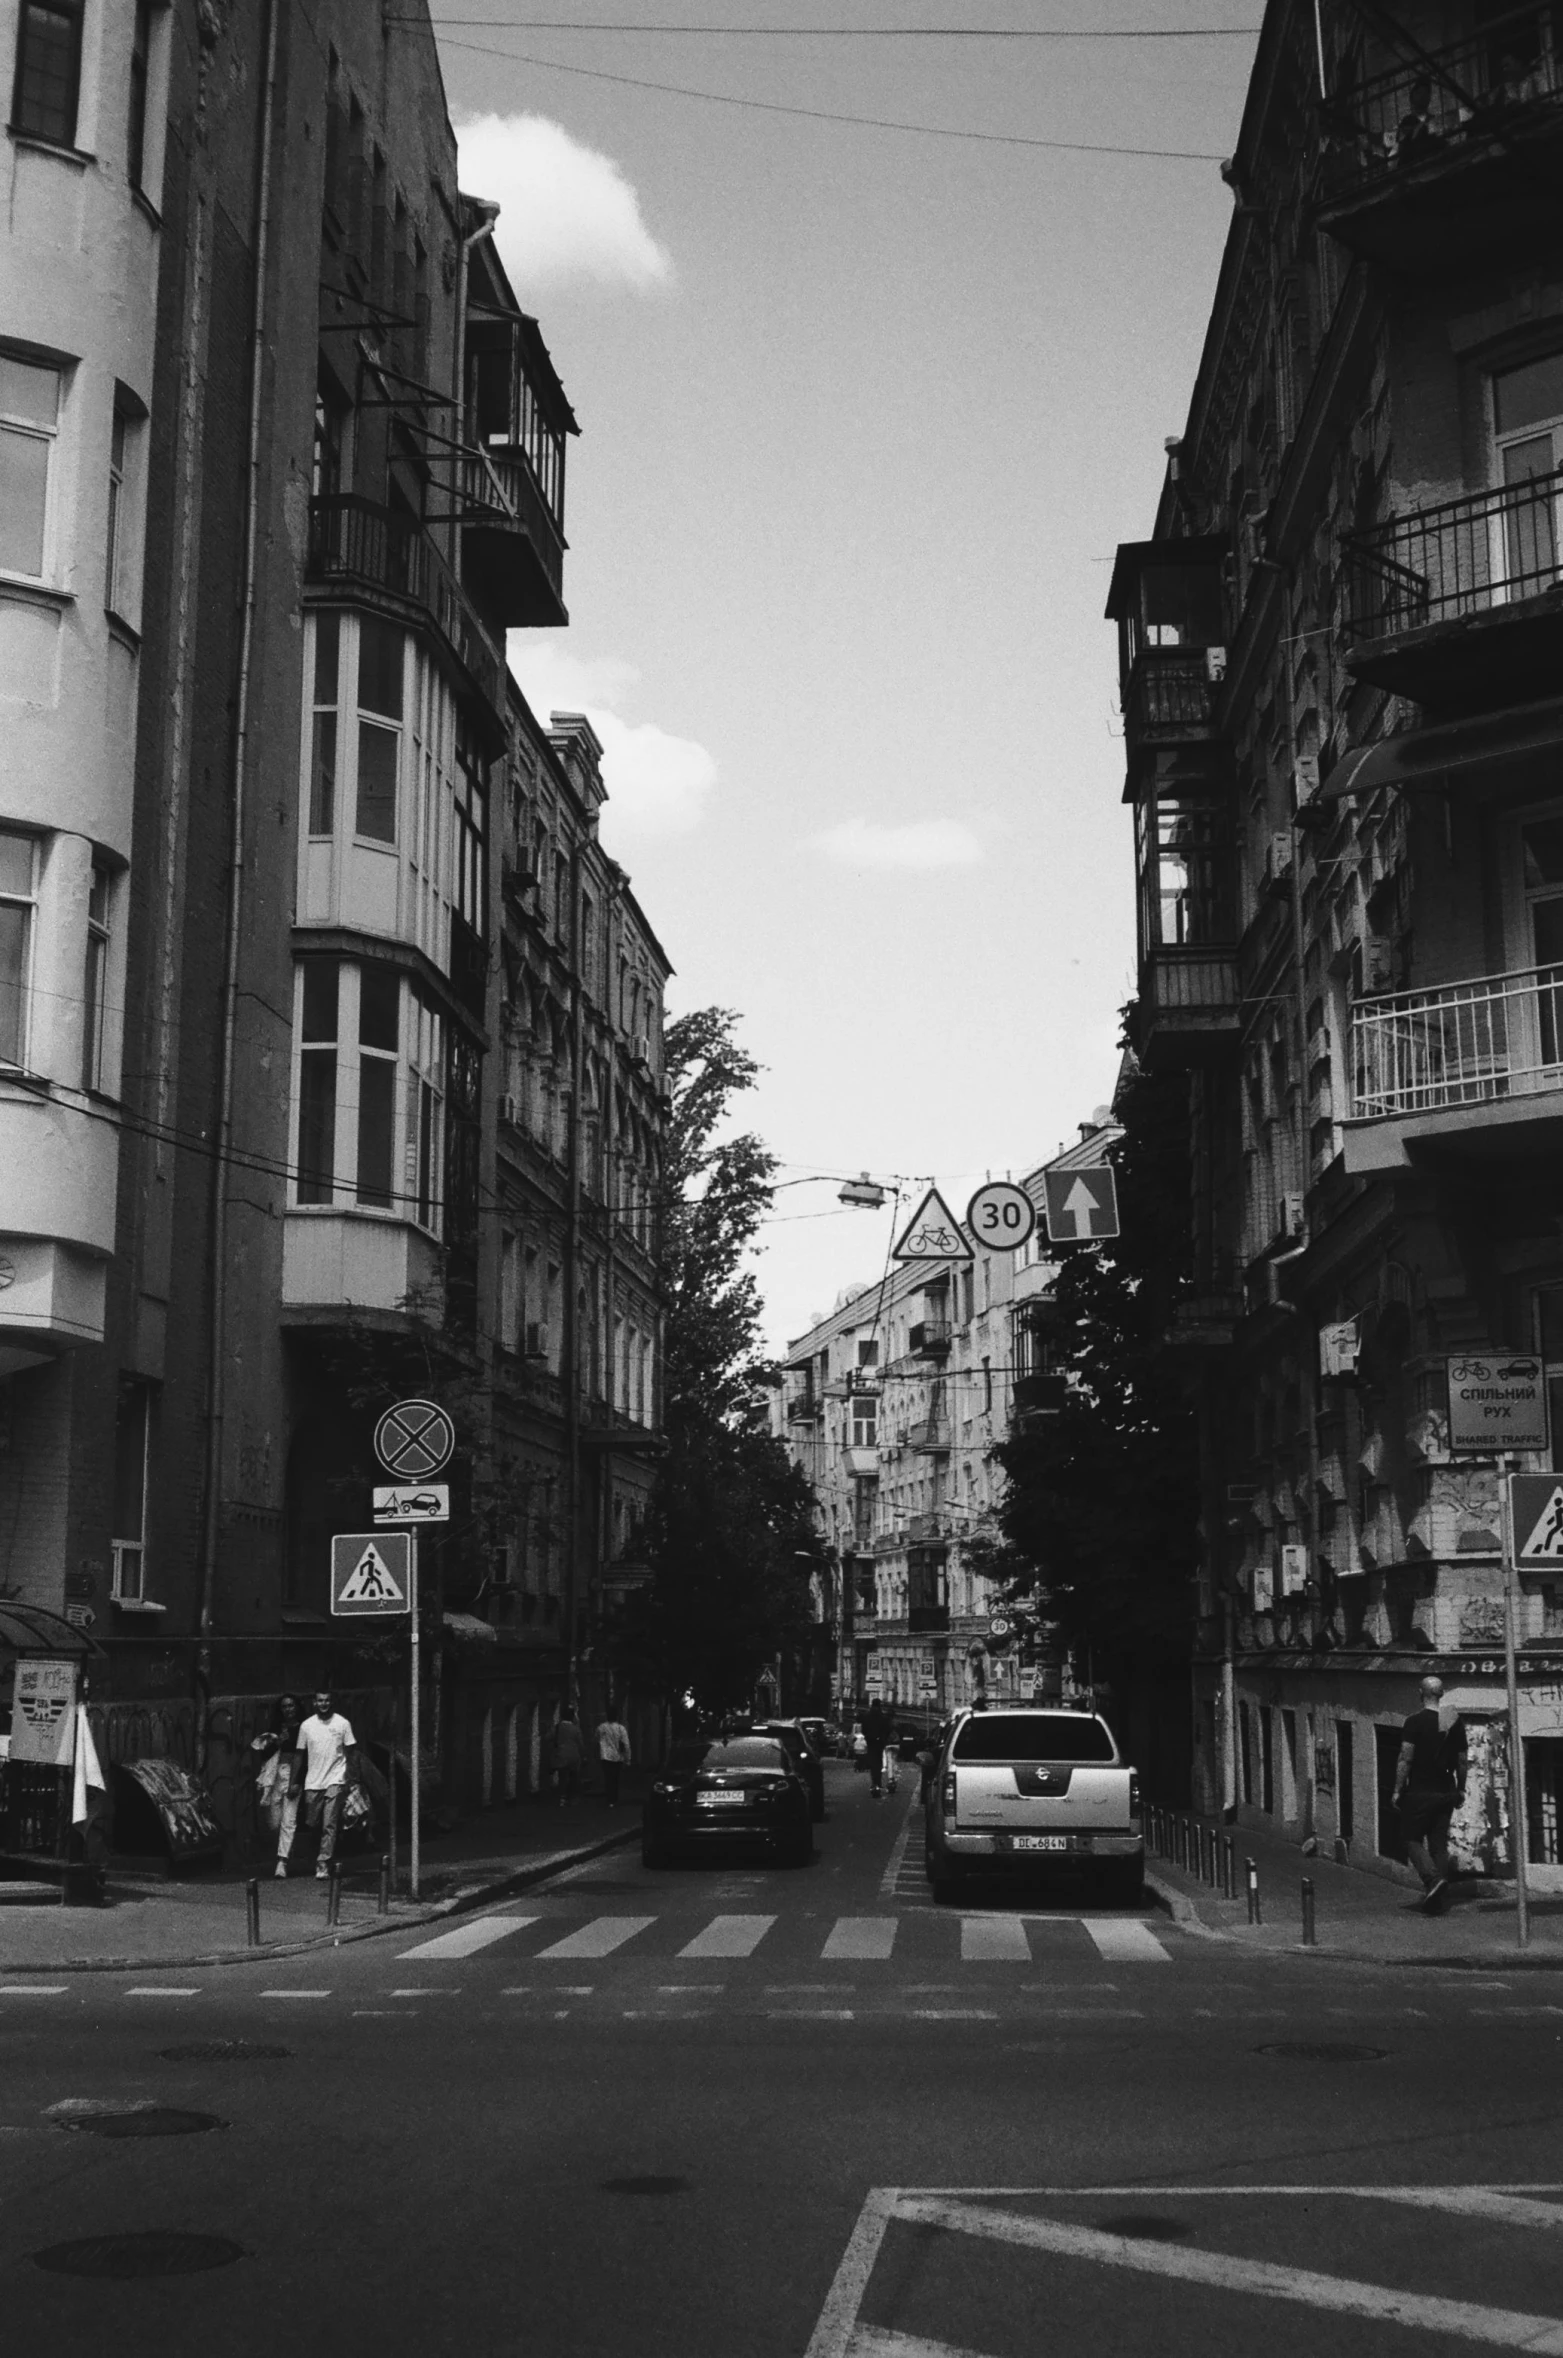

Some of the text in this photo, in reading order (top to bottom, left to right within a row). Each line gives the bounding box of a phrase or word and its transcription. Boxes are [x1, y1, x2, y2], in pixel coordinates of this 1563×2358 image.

[982, 1202, 1021, 1229] 30
[1460, 1385, 1536, 1400] СПІЛЬНИЙ
[1484, 1406, 1512, 1418] РУХ
[1455, 1435, 1542, 1445] SHARED TRAFFIC
[993, 1621, 1006, 1632] 30
